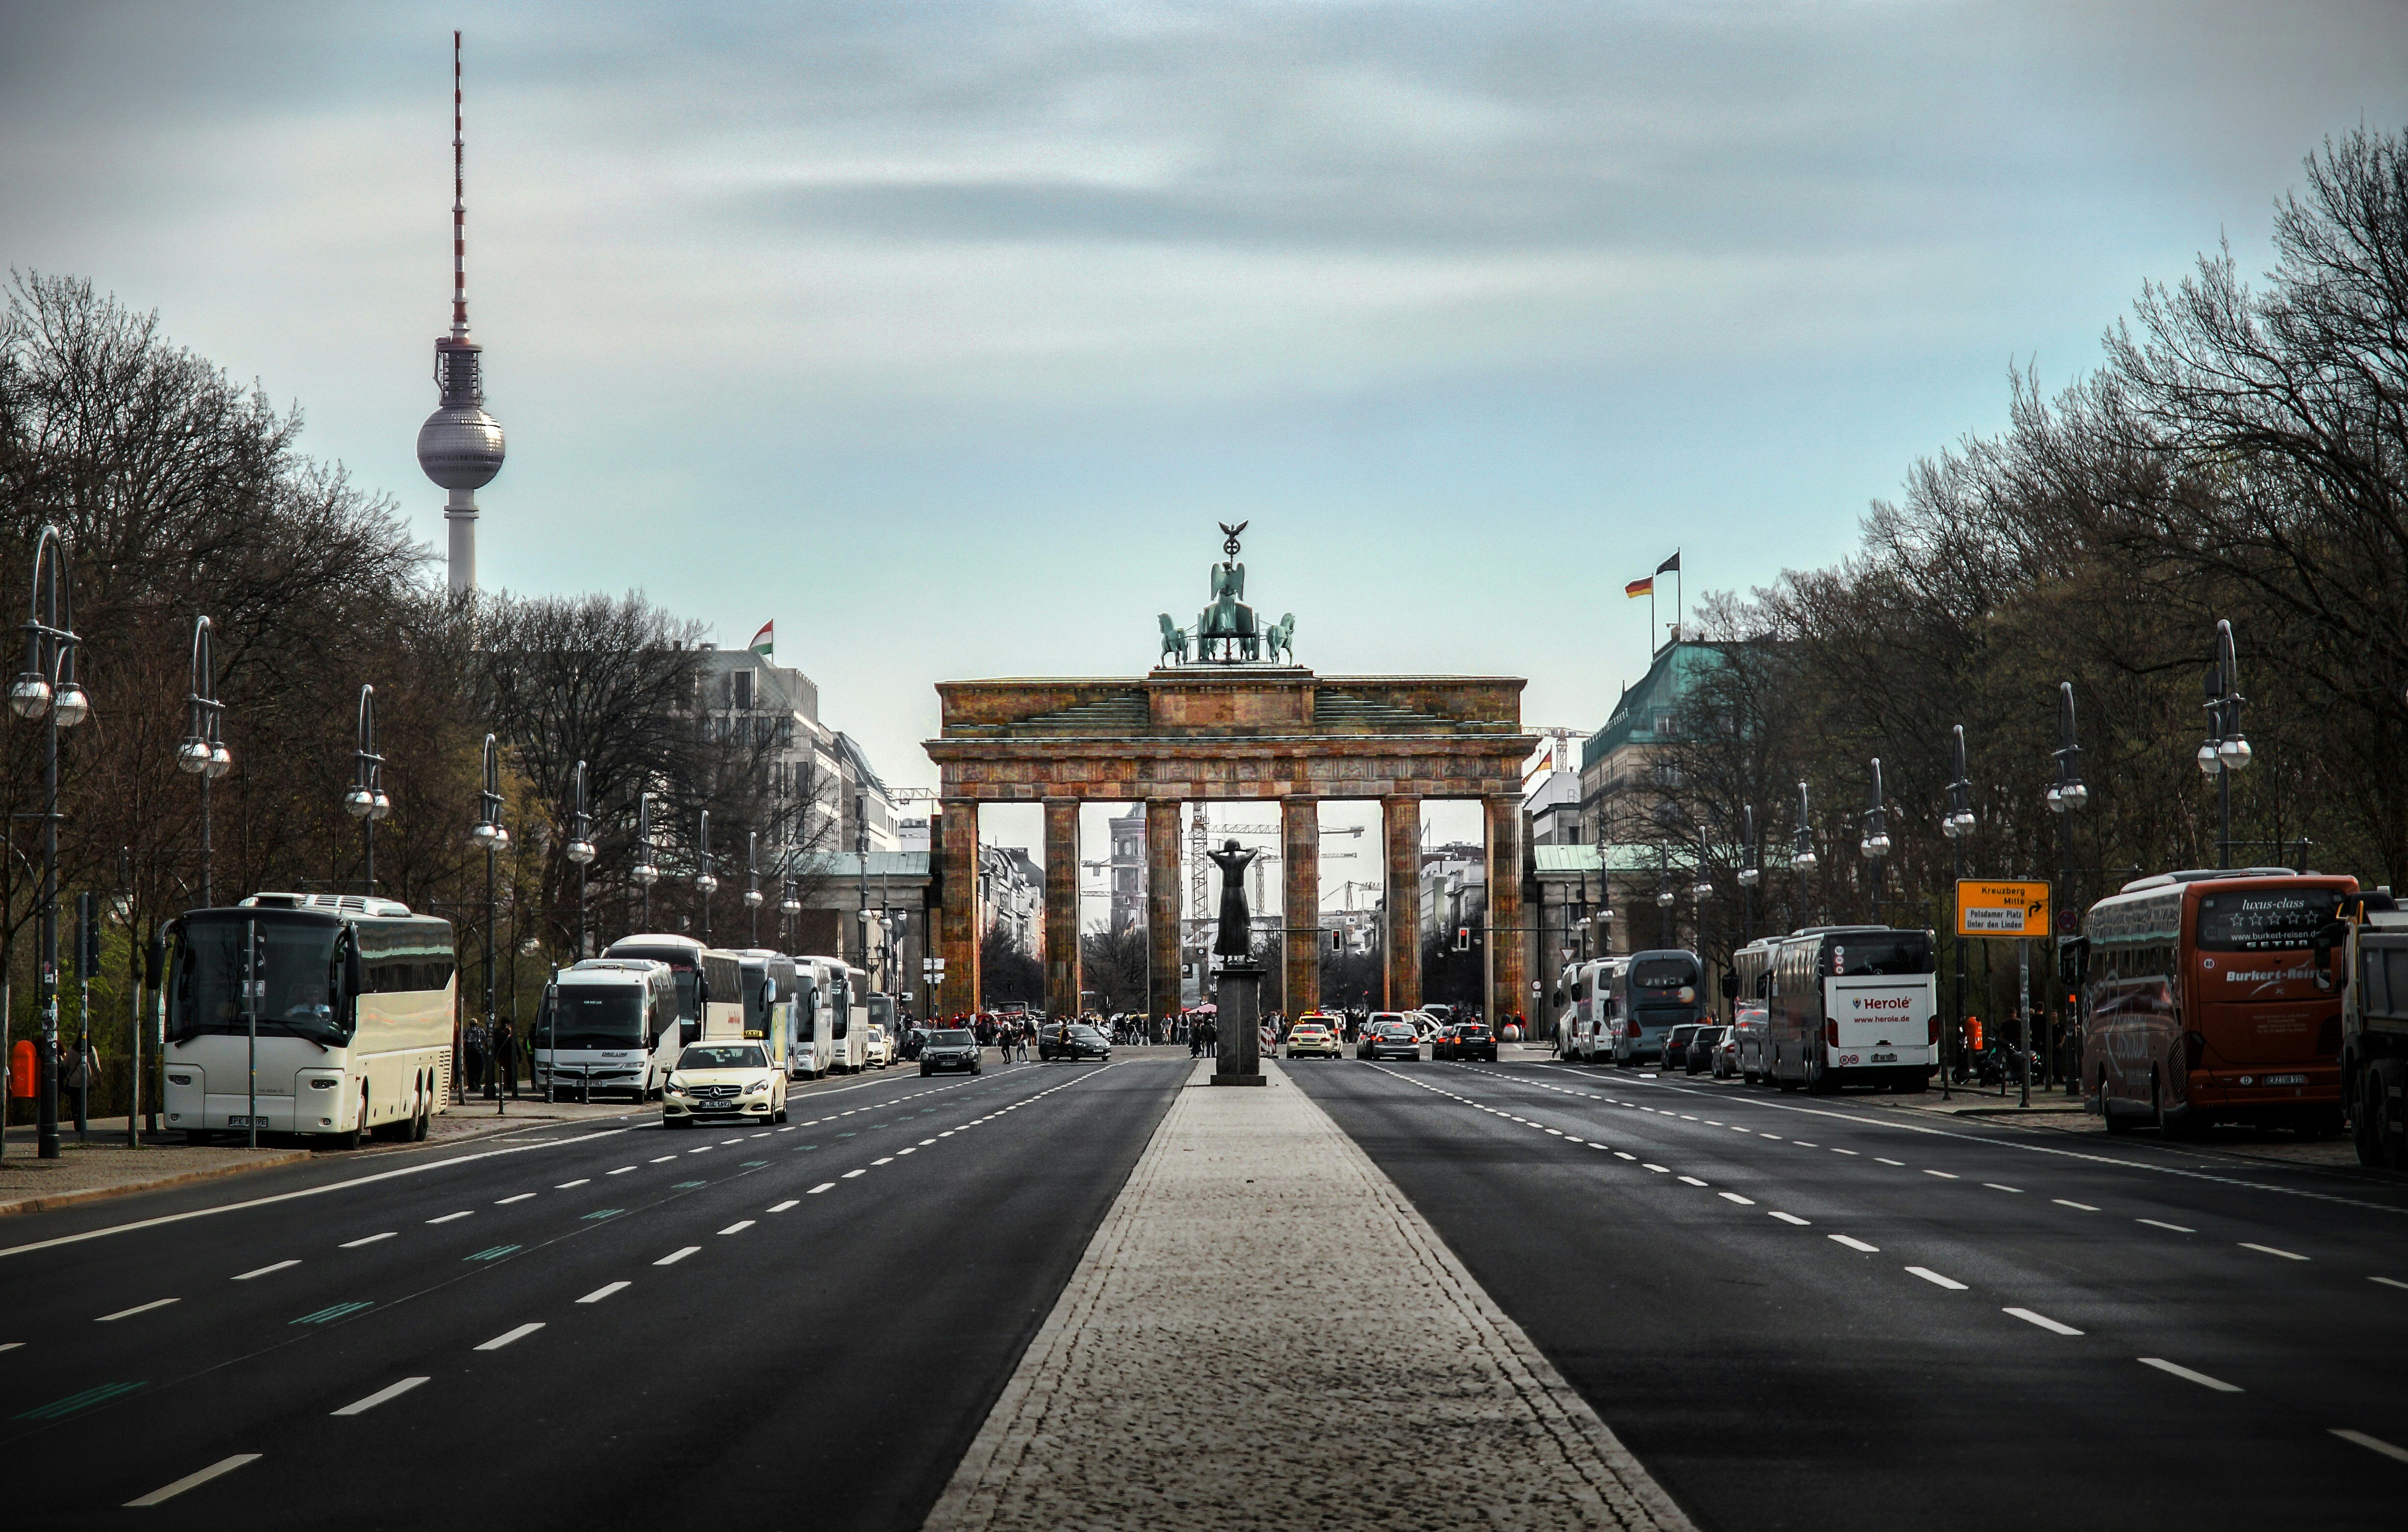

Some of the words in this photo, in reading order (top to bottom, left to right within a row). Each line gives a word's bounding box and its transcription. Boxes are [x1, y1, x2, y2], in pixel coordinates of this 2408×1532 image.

[1982, 886, 2025, 895] Kreuzberg
[2242, 897, 2304, 910] luxus-class
[1970, 910, 2004, 918] Potsdamer
[2006, 910, 2022, 918] Platz
[1967, 919, 1984, 928] Unter
[1987, 920, 1999, 928] den
[2001, 920, 2022, 928] Linden
[1864, 996, 1909, 1009] Herolé
